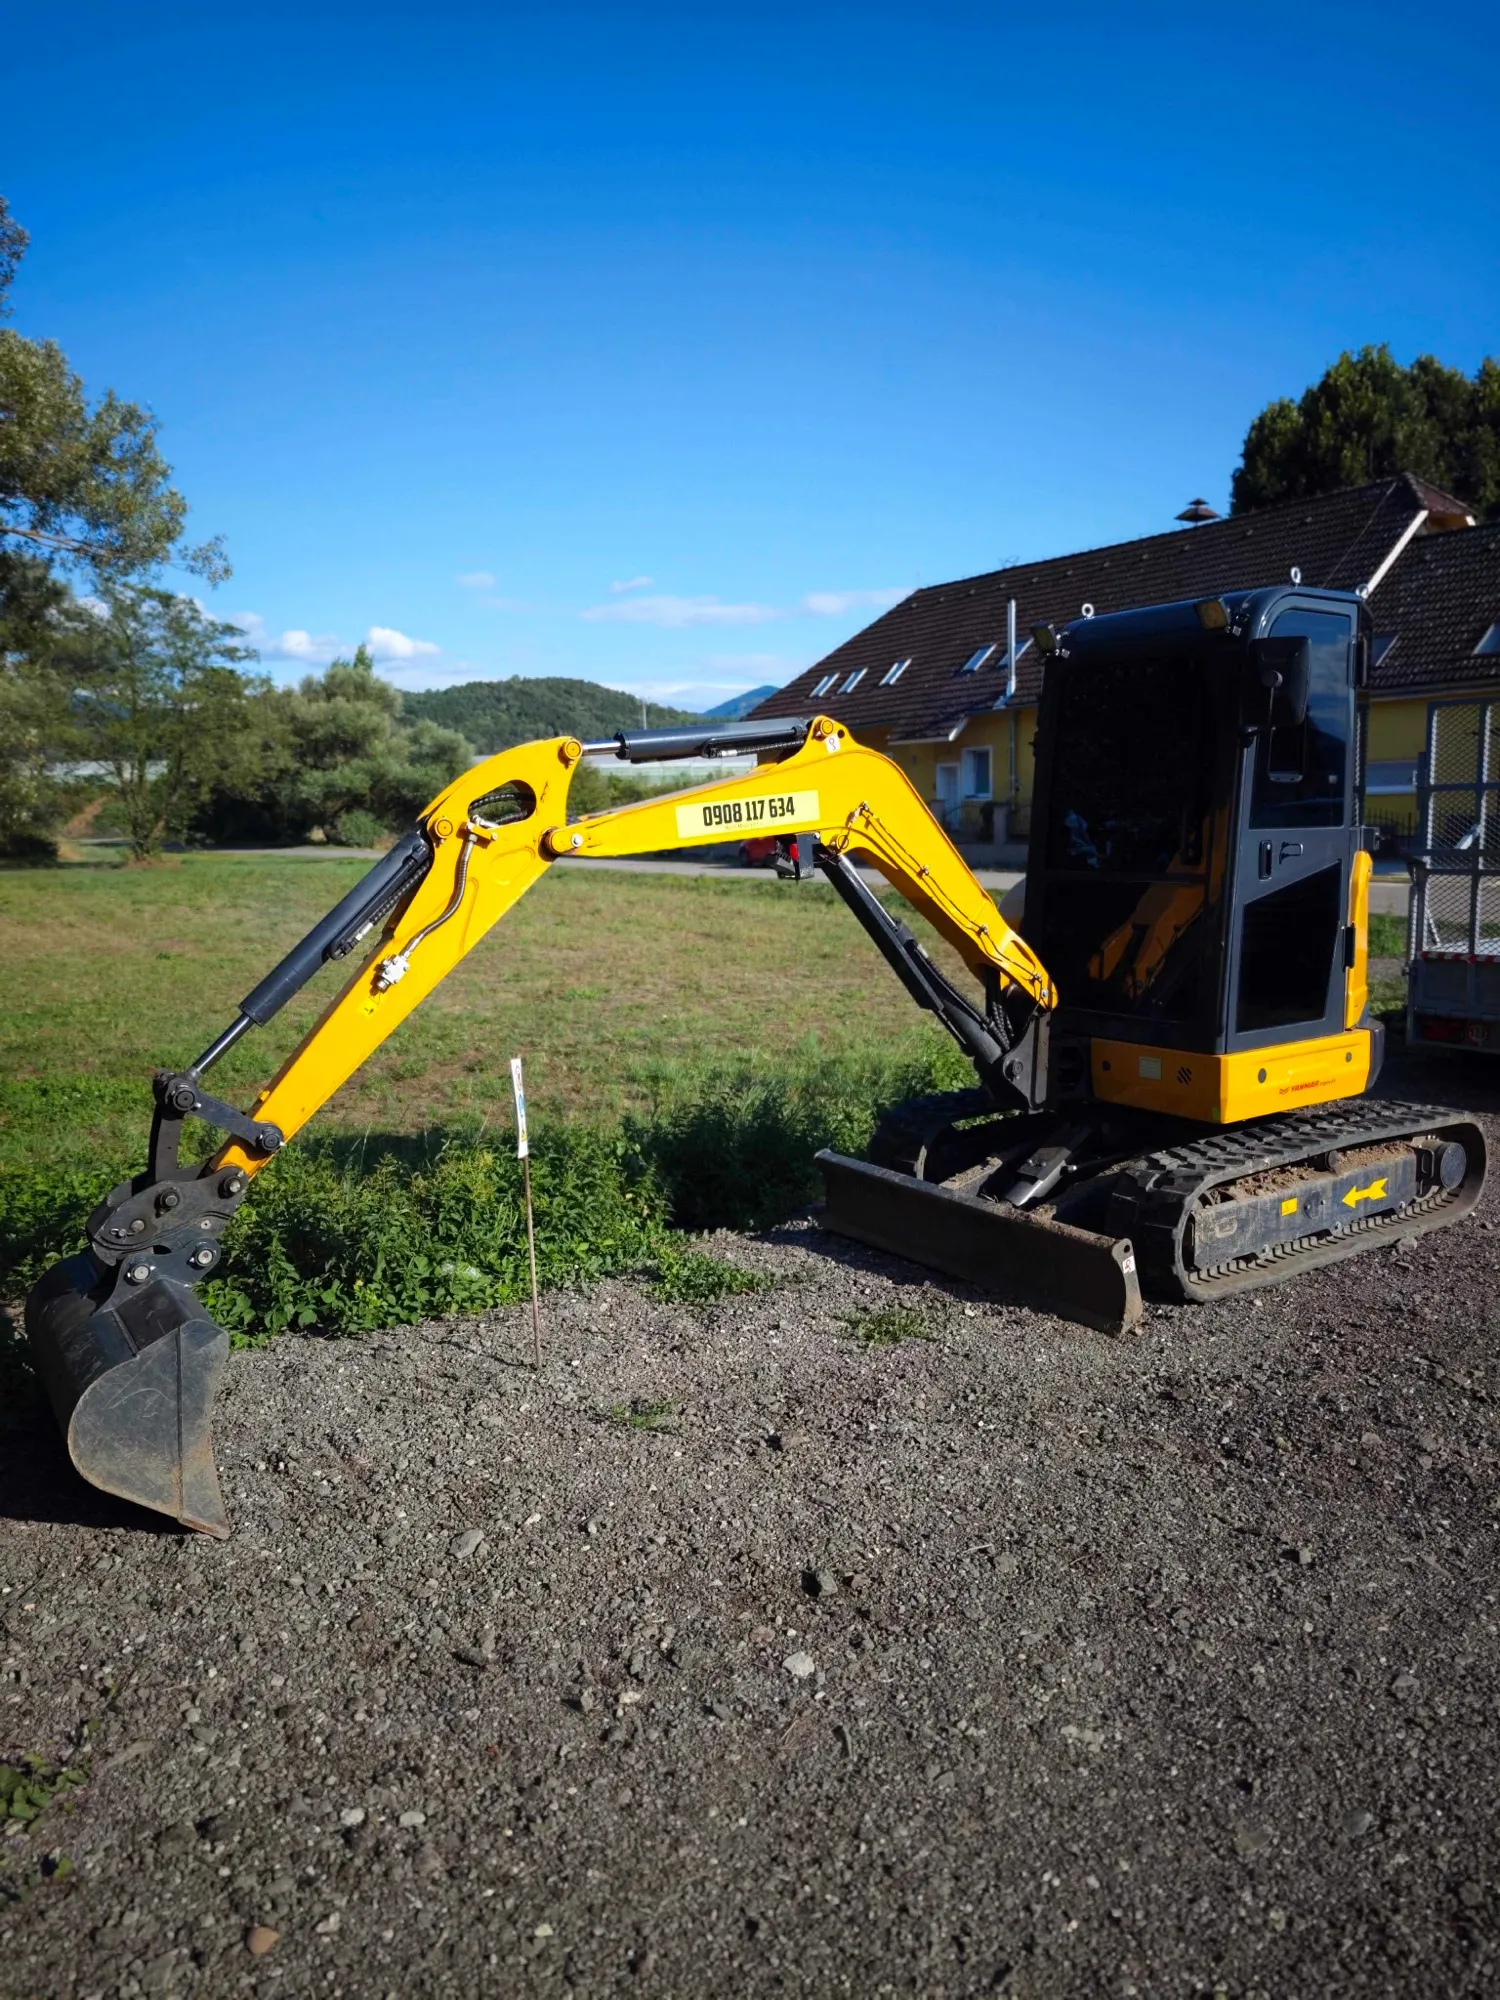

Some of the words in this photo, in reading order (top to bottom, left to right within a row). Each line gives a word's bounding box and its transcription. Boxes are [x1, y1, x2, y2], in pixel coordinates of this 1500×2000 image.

[703, 803, 742, 826] 0908
[745, 800, 765, 821] 117
[769, 797, 795, 818] 634
